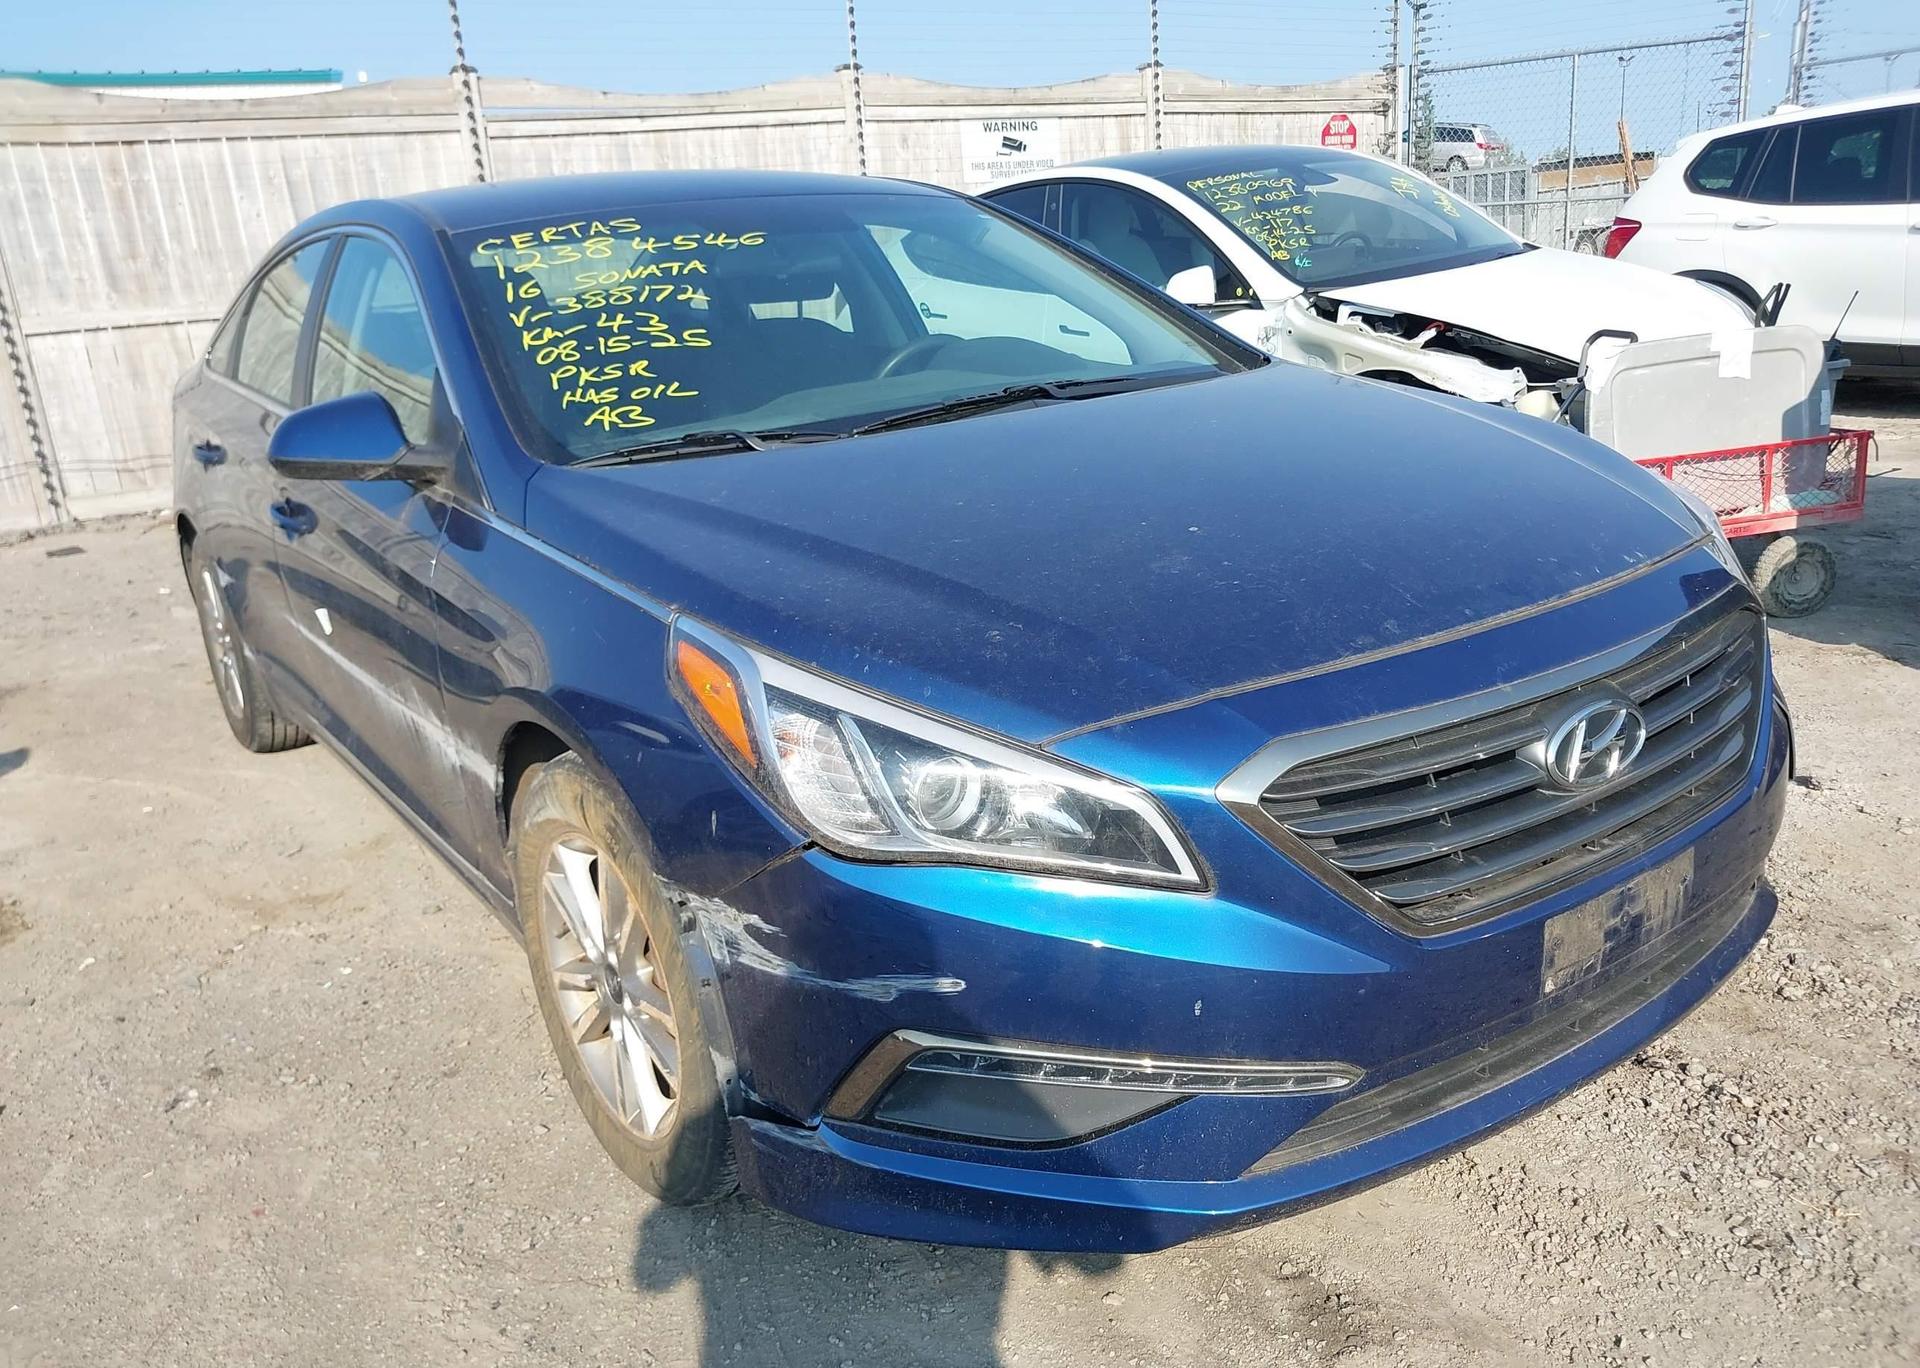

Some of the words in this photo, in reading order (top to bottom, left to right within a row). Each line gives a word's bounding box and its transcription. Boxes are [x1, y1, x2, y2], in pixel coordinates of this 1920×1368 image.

[983, 121, 1038, 133] WARNING
[1329, 120, 1350, 134] STOP
[971, 162, 985, 171] THIS
[987, 161, 1003, 170] AREA
[1005, 161, 1011, 169] IS
[1012, 160, 1034, 169] UNDER
[1036, 159, 1054, 168] VIDEO
[1187, 172, 1264, 192] PERSONAL
[1216, 200, 1246, 213] 22
[1253, 184, 1304, 205] MODEL
[476, 217, 641, 254] CERTAS
[1268, 237, 1312, 250] PKSR
[506, 280, 541, 303] 16
[569, 259, 708, 291] SONATA
[536, 329, 712, 365] 08-15-25
[550, 360, 658, 390] PKSR
[562, 388, 619, 409] HAS
[630, 381, 700, 399] OIL
[584, 405, 656, 431] AB
